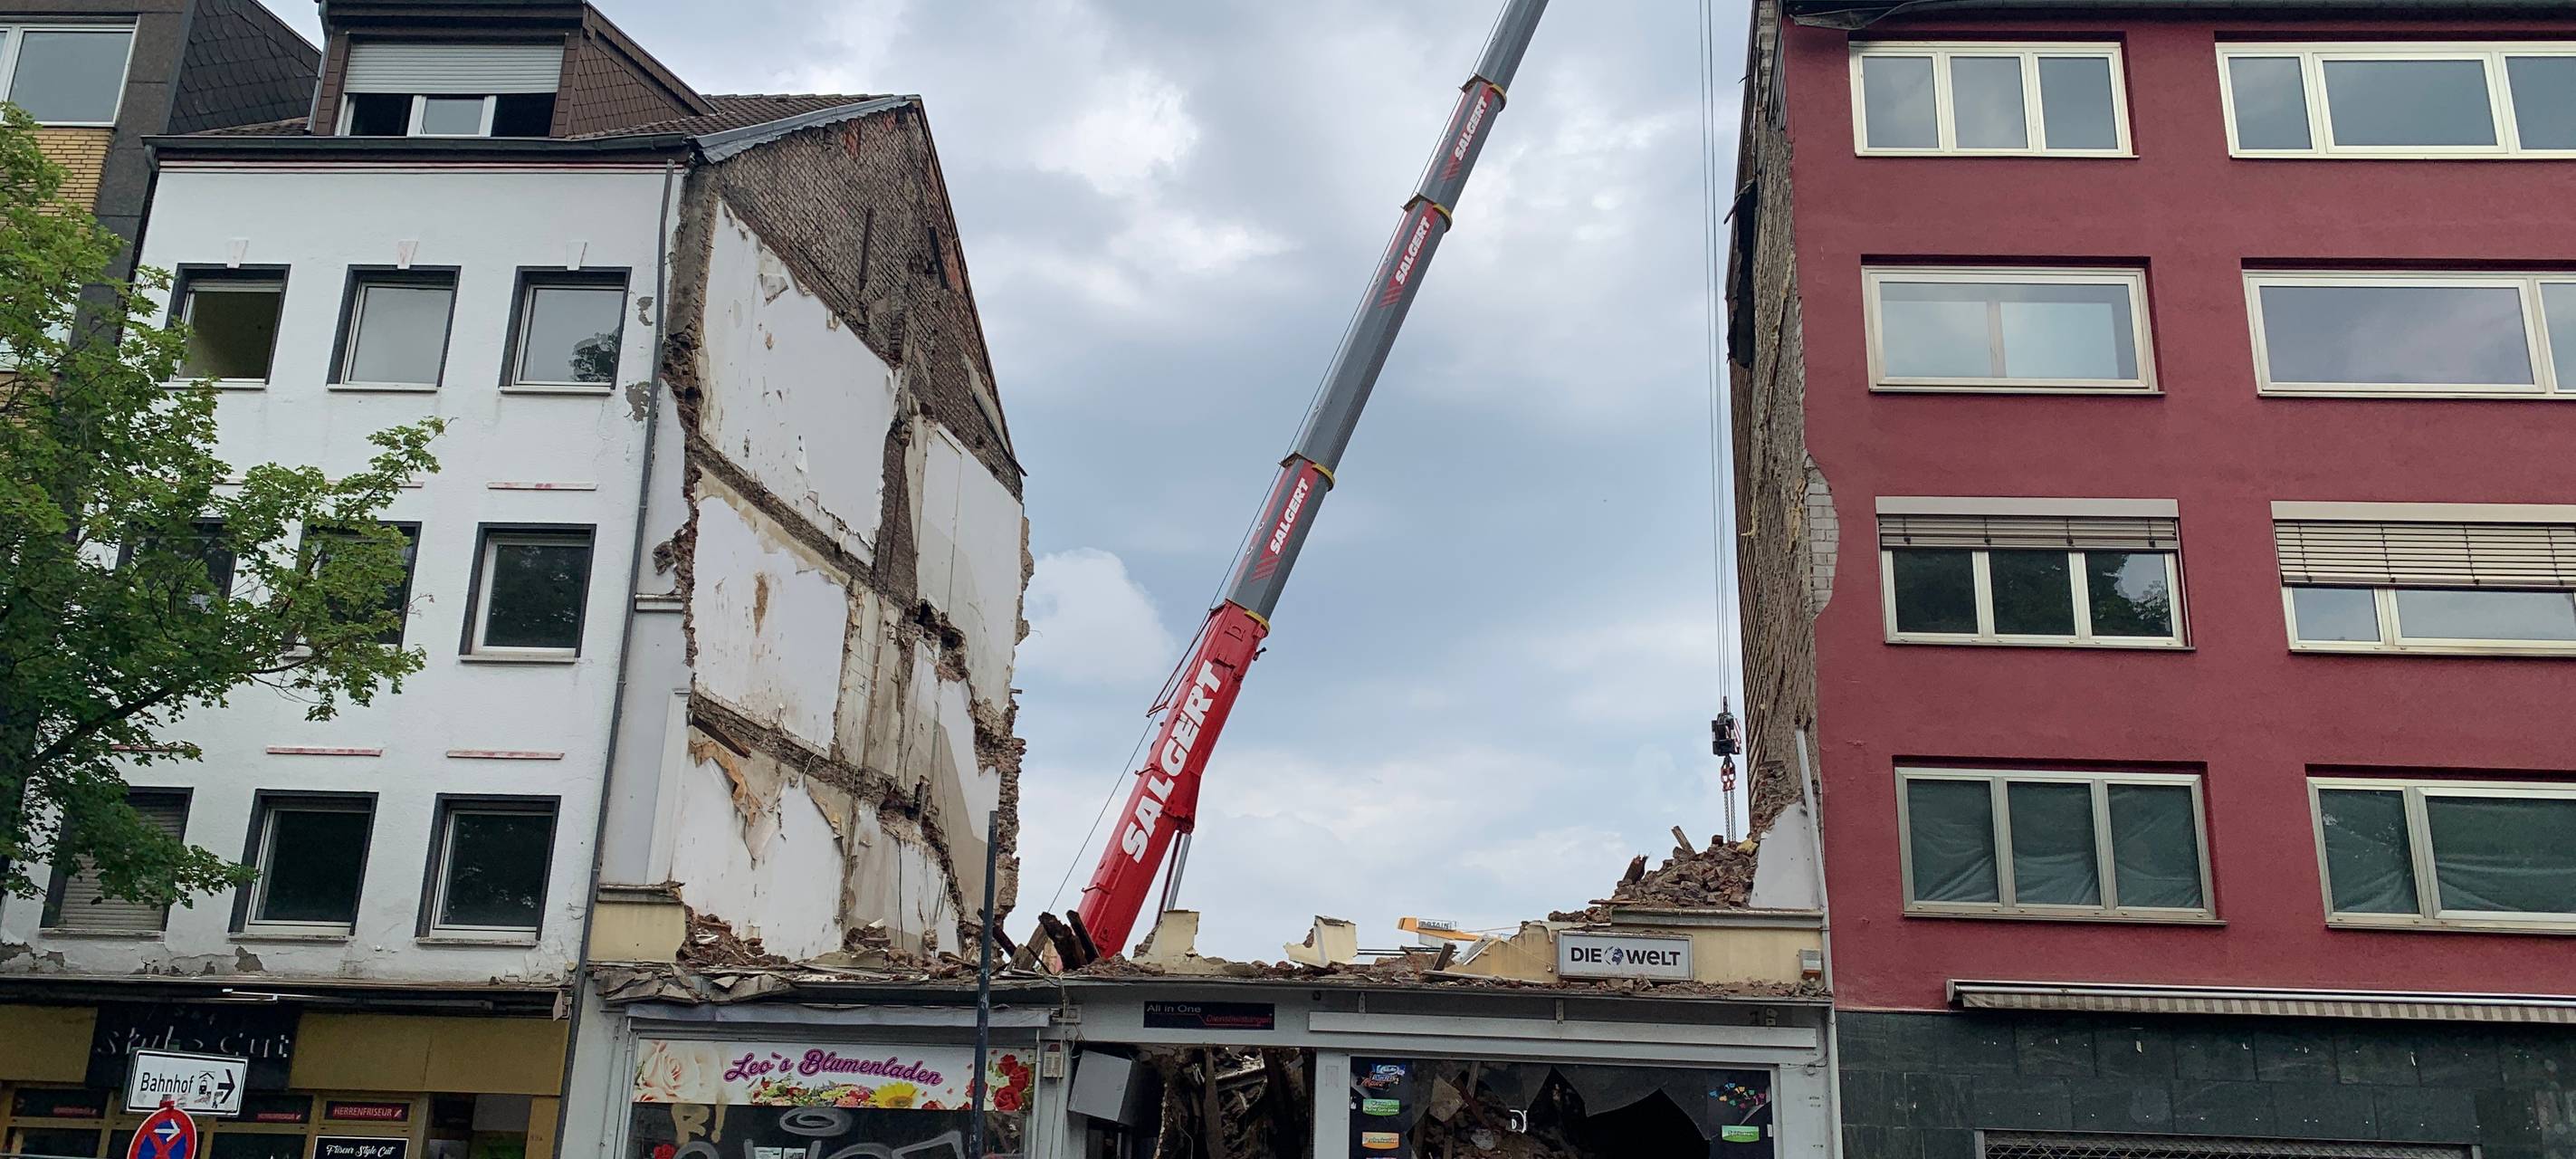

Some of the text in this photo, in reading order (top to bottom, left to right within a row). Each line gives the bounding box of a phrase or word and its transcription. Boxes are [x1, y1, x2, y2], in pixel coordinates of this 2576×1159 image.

[1454, 96, 1488, 160] SALGERT
[1395, 216, 1431, 284] SALGERT
[1269, 477, 1309, 555] SALGERT
[1121, 659, 1222, 864] SALGERT
[1570, 947, 1601, 963] DIE
[1147, 1004, 1201, 1013] All in One
[140, 1072, 194, 1094] Bahnhof
[797, 1049, 943, 1087] Blumenladen
[333, 1106, 392, 1116] HERRENFRISEUR
[326, 1145, 396, 1157] Friseur Style Cut
